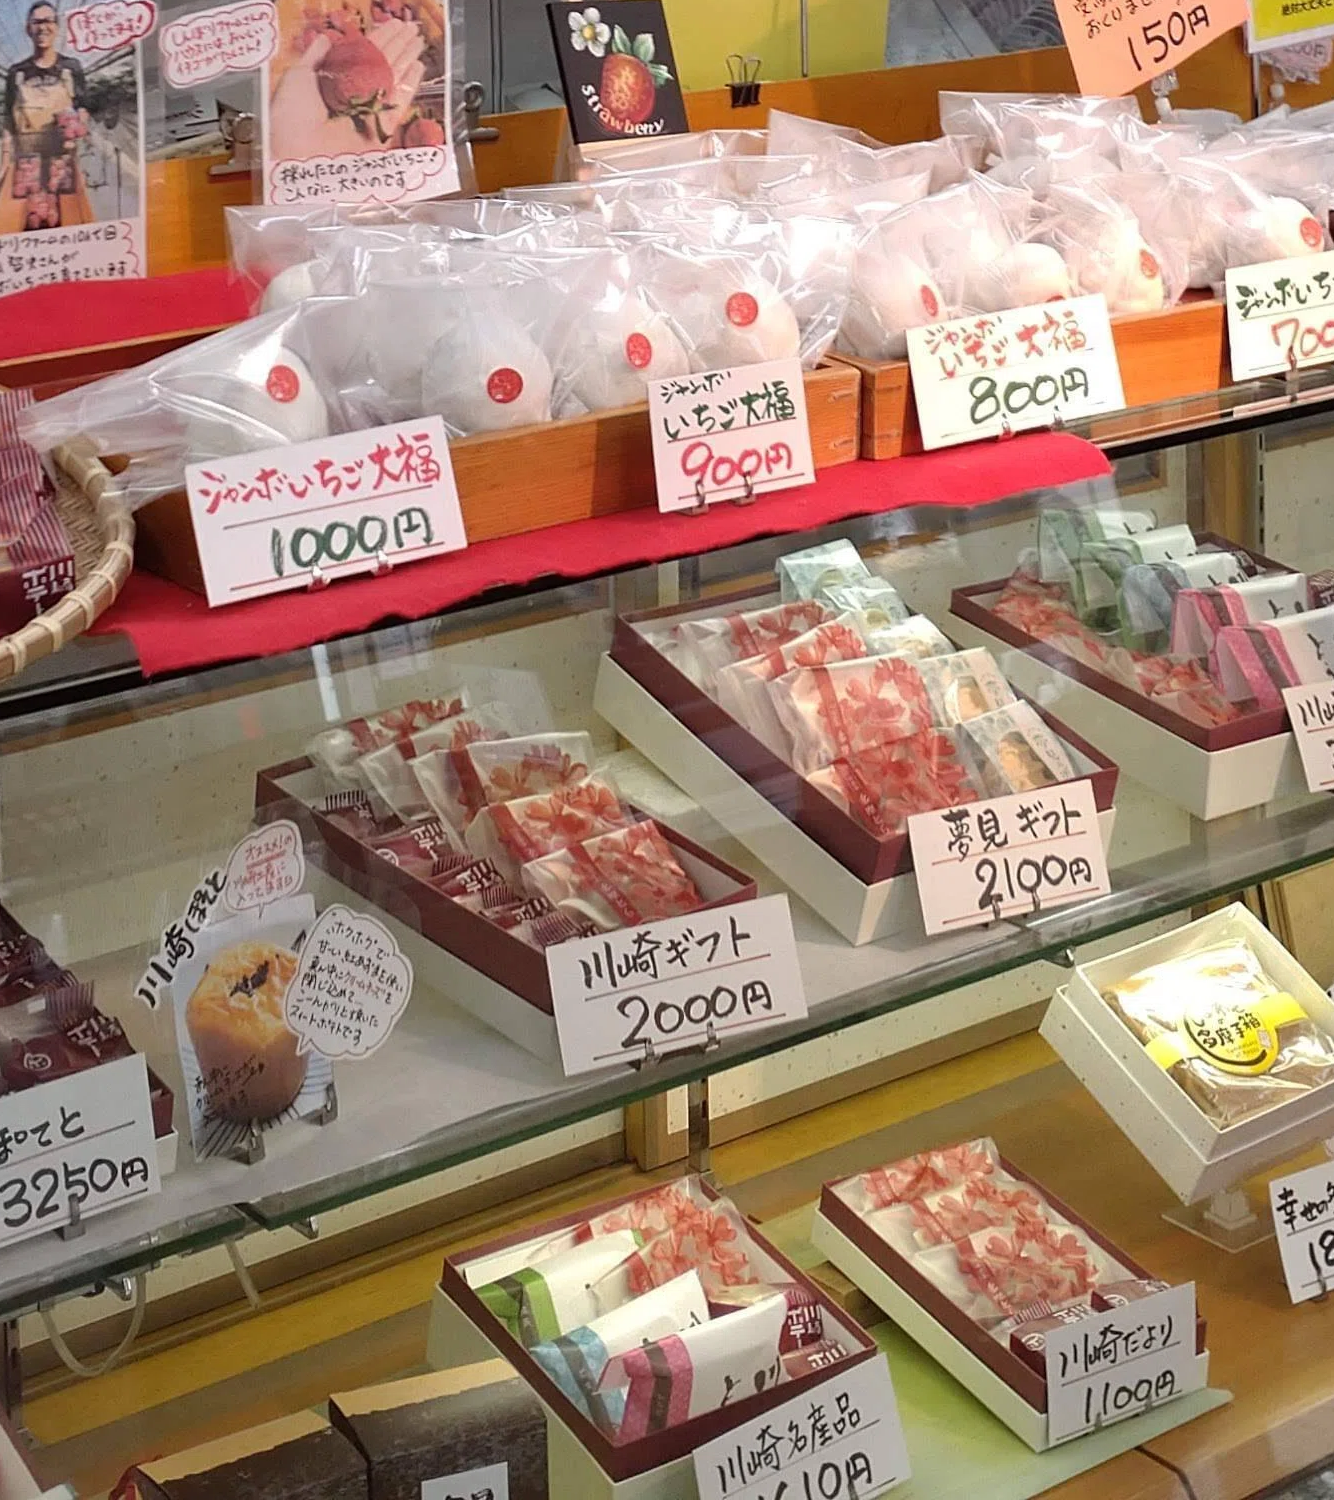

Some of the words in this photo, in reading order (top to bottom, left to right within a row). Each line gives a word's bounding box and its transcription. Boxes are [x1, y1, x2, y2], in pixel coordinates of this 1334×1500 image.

[1127, 4, 1210, 72] 150円
[580, 81, 665, 136] strawberry
[924, 314, 1005, 354] ジャンボ
[939, 309, 1088, 379] いちご大福
[659, 370, 733, 404] ジャンボ
[662, 380, 798, 441] いちご大福
[969, 366, 1090, 426] 800円
[199, 430, 443, 515] ジャンボいちご大福
[680, 440, 794, 485] 900円
[269, 505, 434, 576] 1000円
[946, 805, 1010, 863] 夢見
[1017, 796, 1084, 839] ギフト
[975, 853, 1094, 912] 2100円
[134, 867, 229, 1009] 川崎ぽてと
[578, 917, 755, 990] 川崎ギフト
[619, 977, 773, 1048] 2000円
[1197, 1012, 1261, 1049] 多摩手箱
[1058, 1315, 1178, 1379] 川崎だより
[1082, 1370, 1180, 1426] 1100円
[715, 1391, 863, 1495] 川崎名産品
